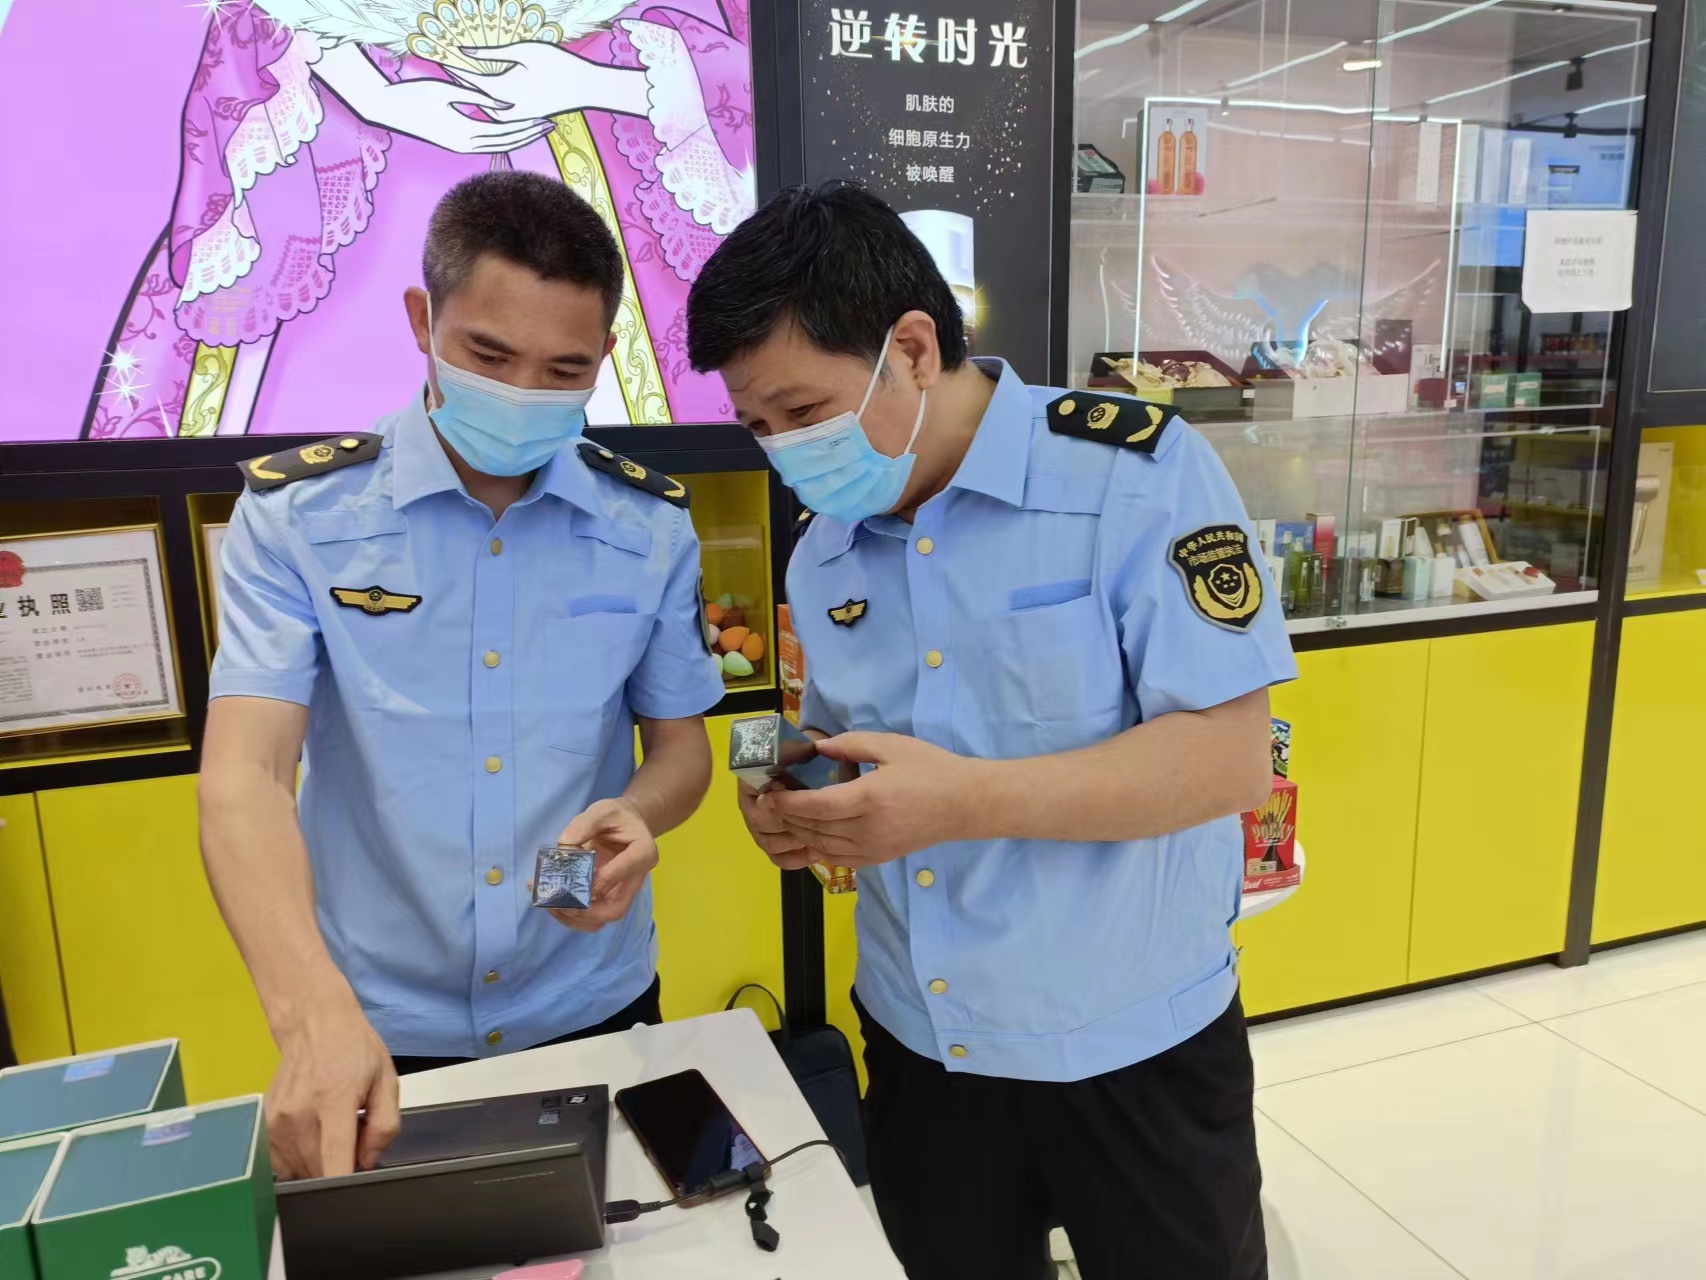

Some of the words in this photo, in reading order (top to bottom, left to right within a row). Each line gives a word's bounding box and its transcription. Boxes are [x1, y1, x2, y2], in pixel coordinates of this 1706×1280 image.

[829, 8, 1028, 68] 逆转时光
[905, 94, 955, 114] 肌肤的
[888, 128, 970, 150] 细胞原生力
[905, 164, 955, 184] 被唤醒
[1178, 531, 1244, 558] 中华人民共和国
